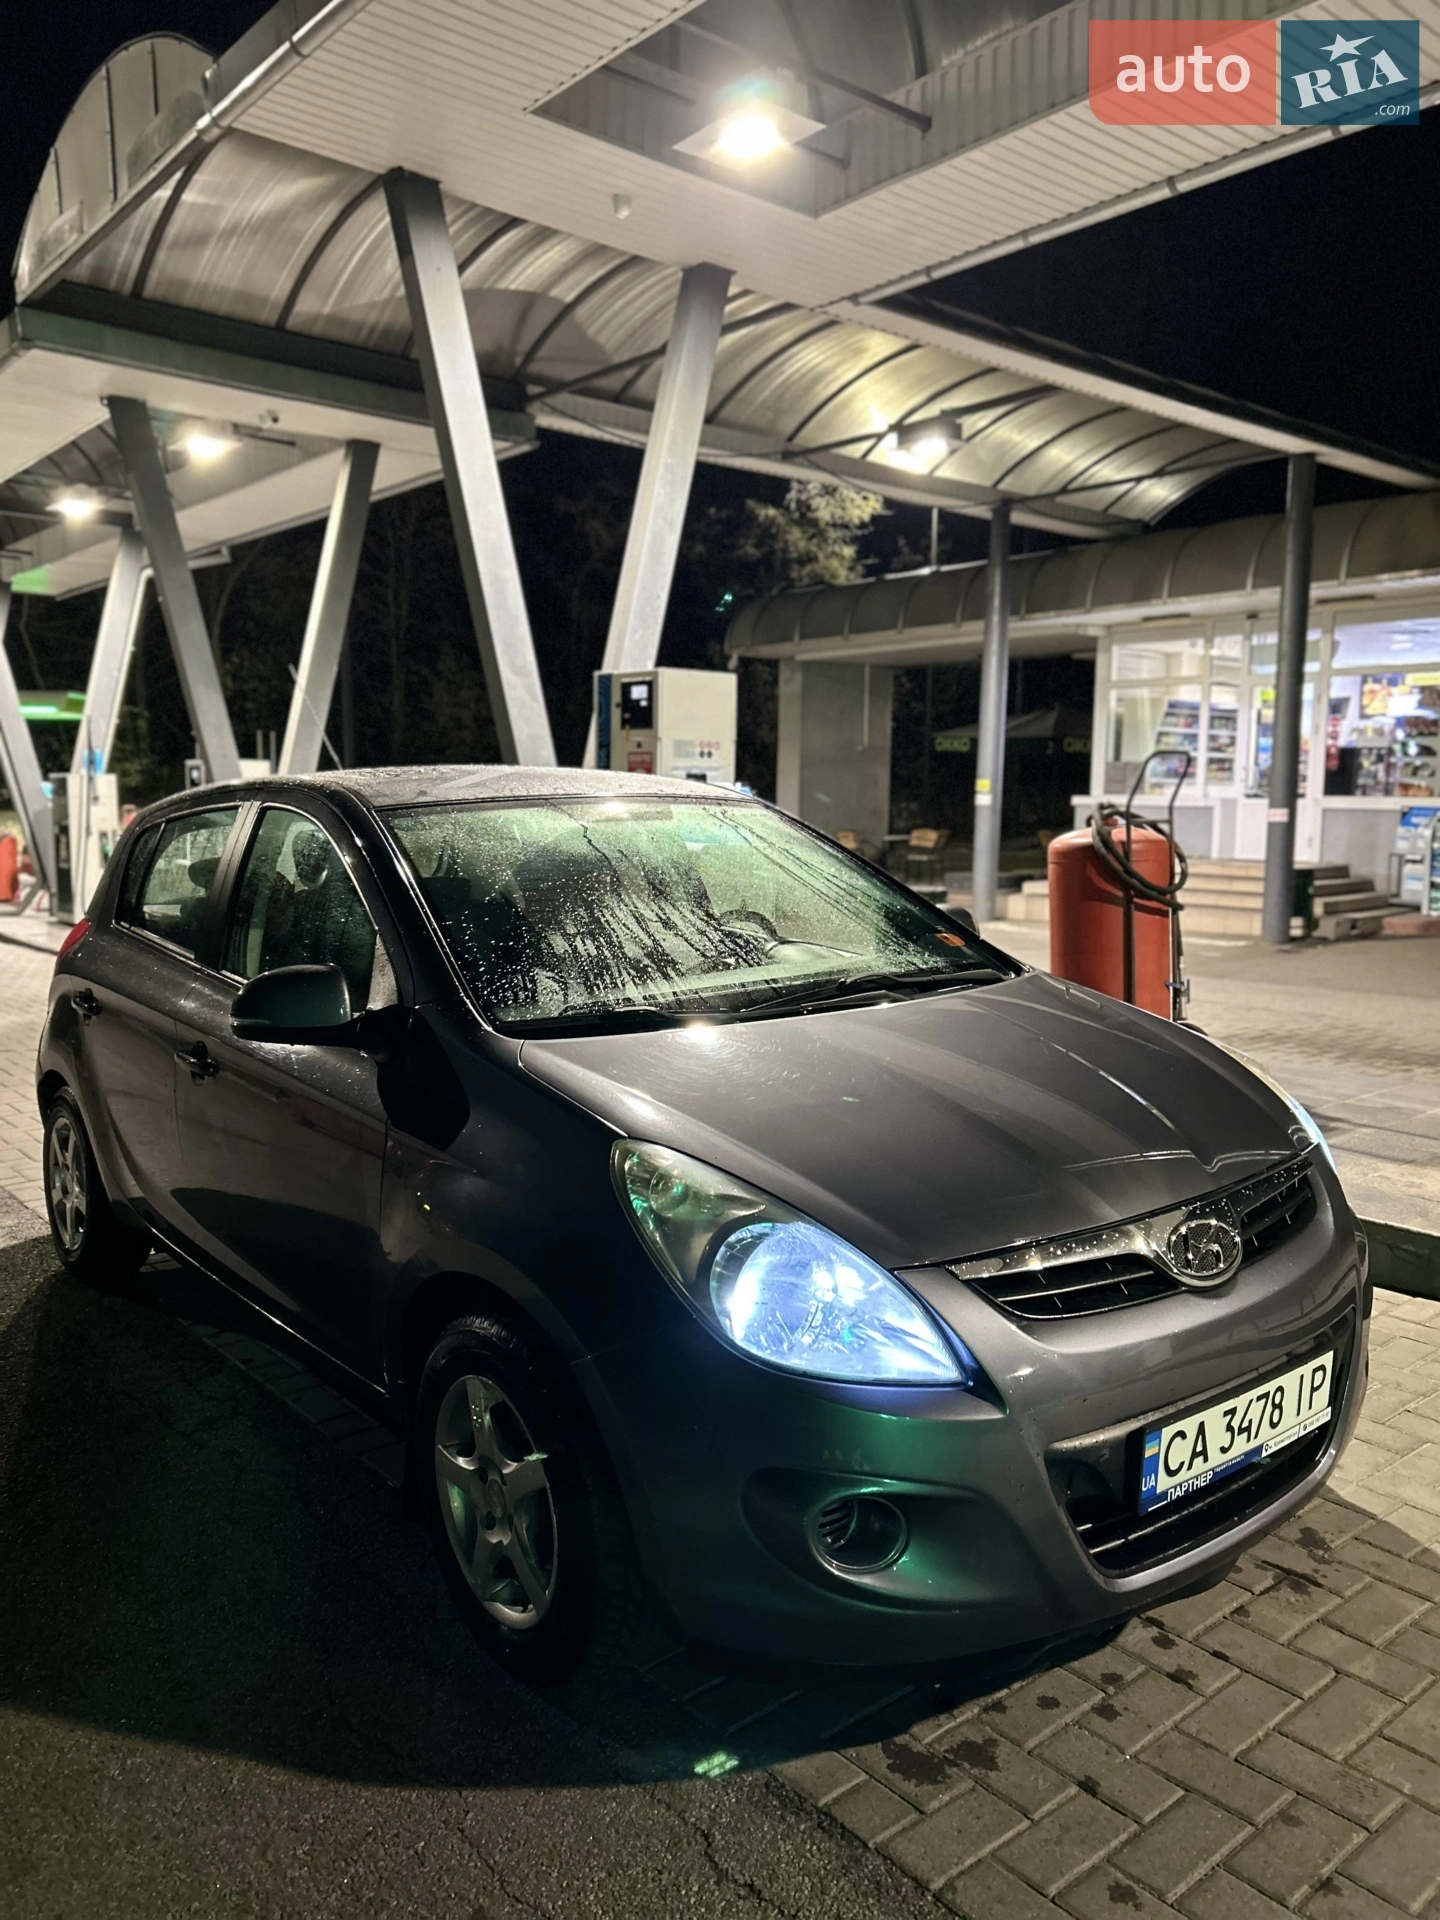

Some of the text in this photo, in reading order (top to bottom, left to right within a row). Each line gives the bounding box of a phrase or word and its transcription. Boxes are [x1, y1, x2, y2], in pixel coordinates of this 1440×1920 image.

[1163, 1364, 1327, 1477] CA 3478 IP
[1142, 1473, 1156, 1492] UA
[1167, 1471, 1213, 1502] ПАРТНЕР
